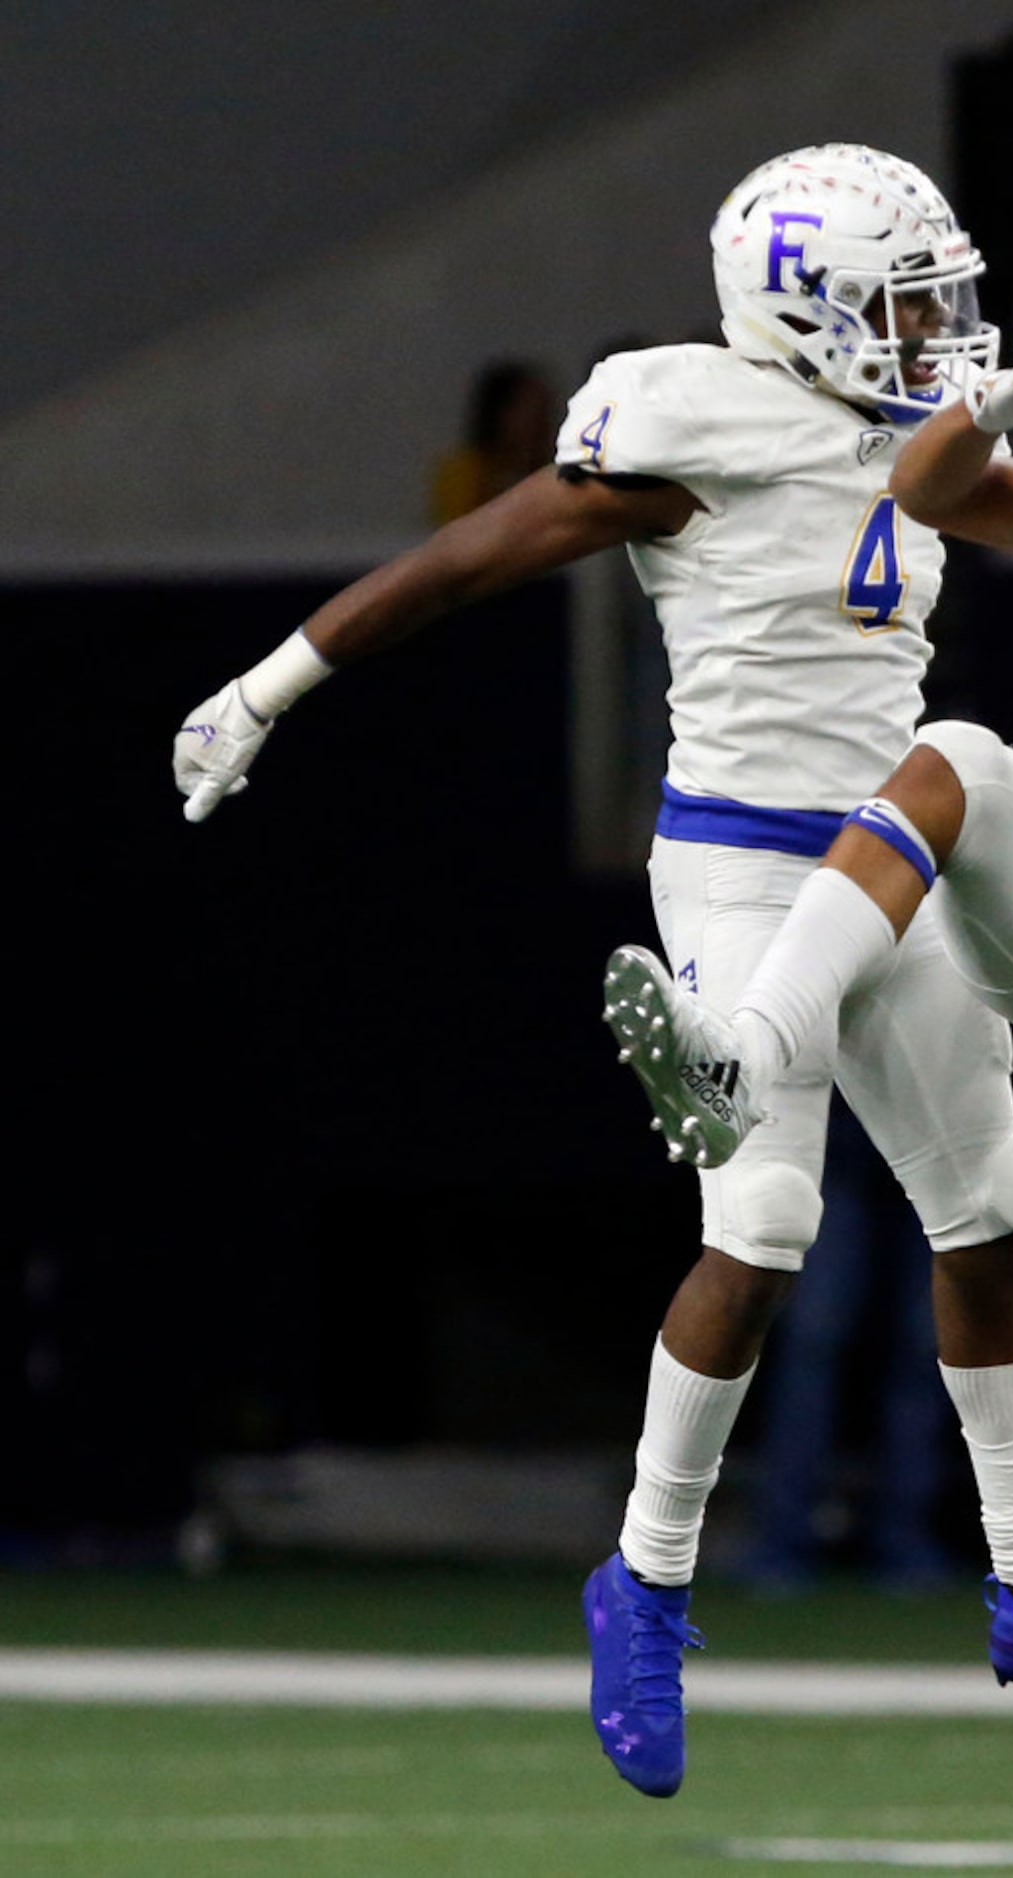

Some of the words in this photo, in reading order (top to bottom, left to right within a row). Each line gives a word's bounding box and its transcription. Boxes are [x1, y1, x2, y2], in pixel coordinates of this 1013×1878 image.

[761, 210, 824, 294] F
[576, 399, 618, 473] 4
[839, 488, 910, 637] 4
[678, 1063, 733, 1123] adidas
